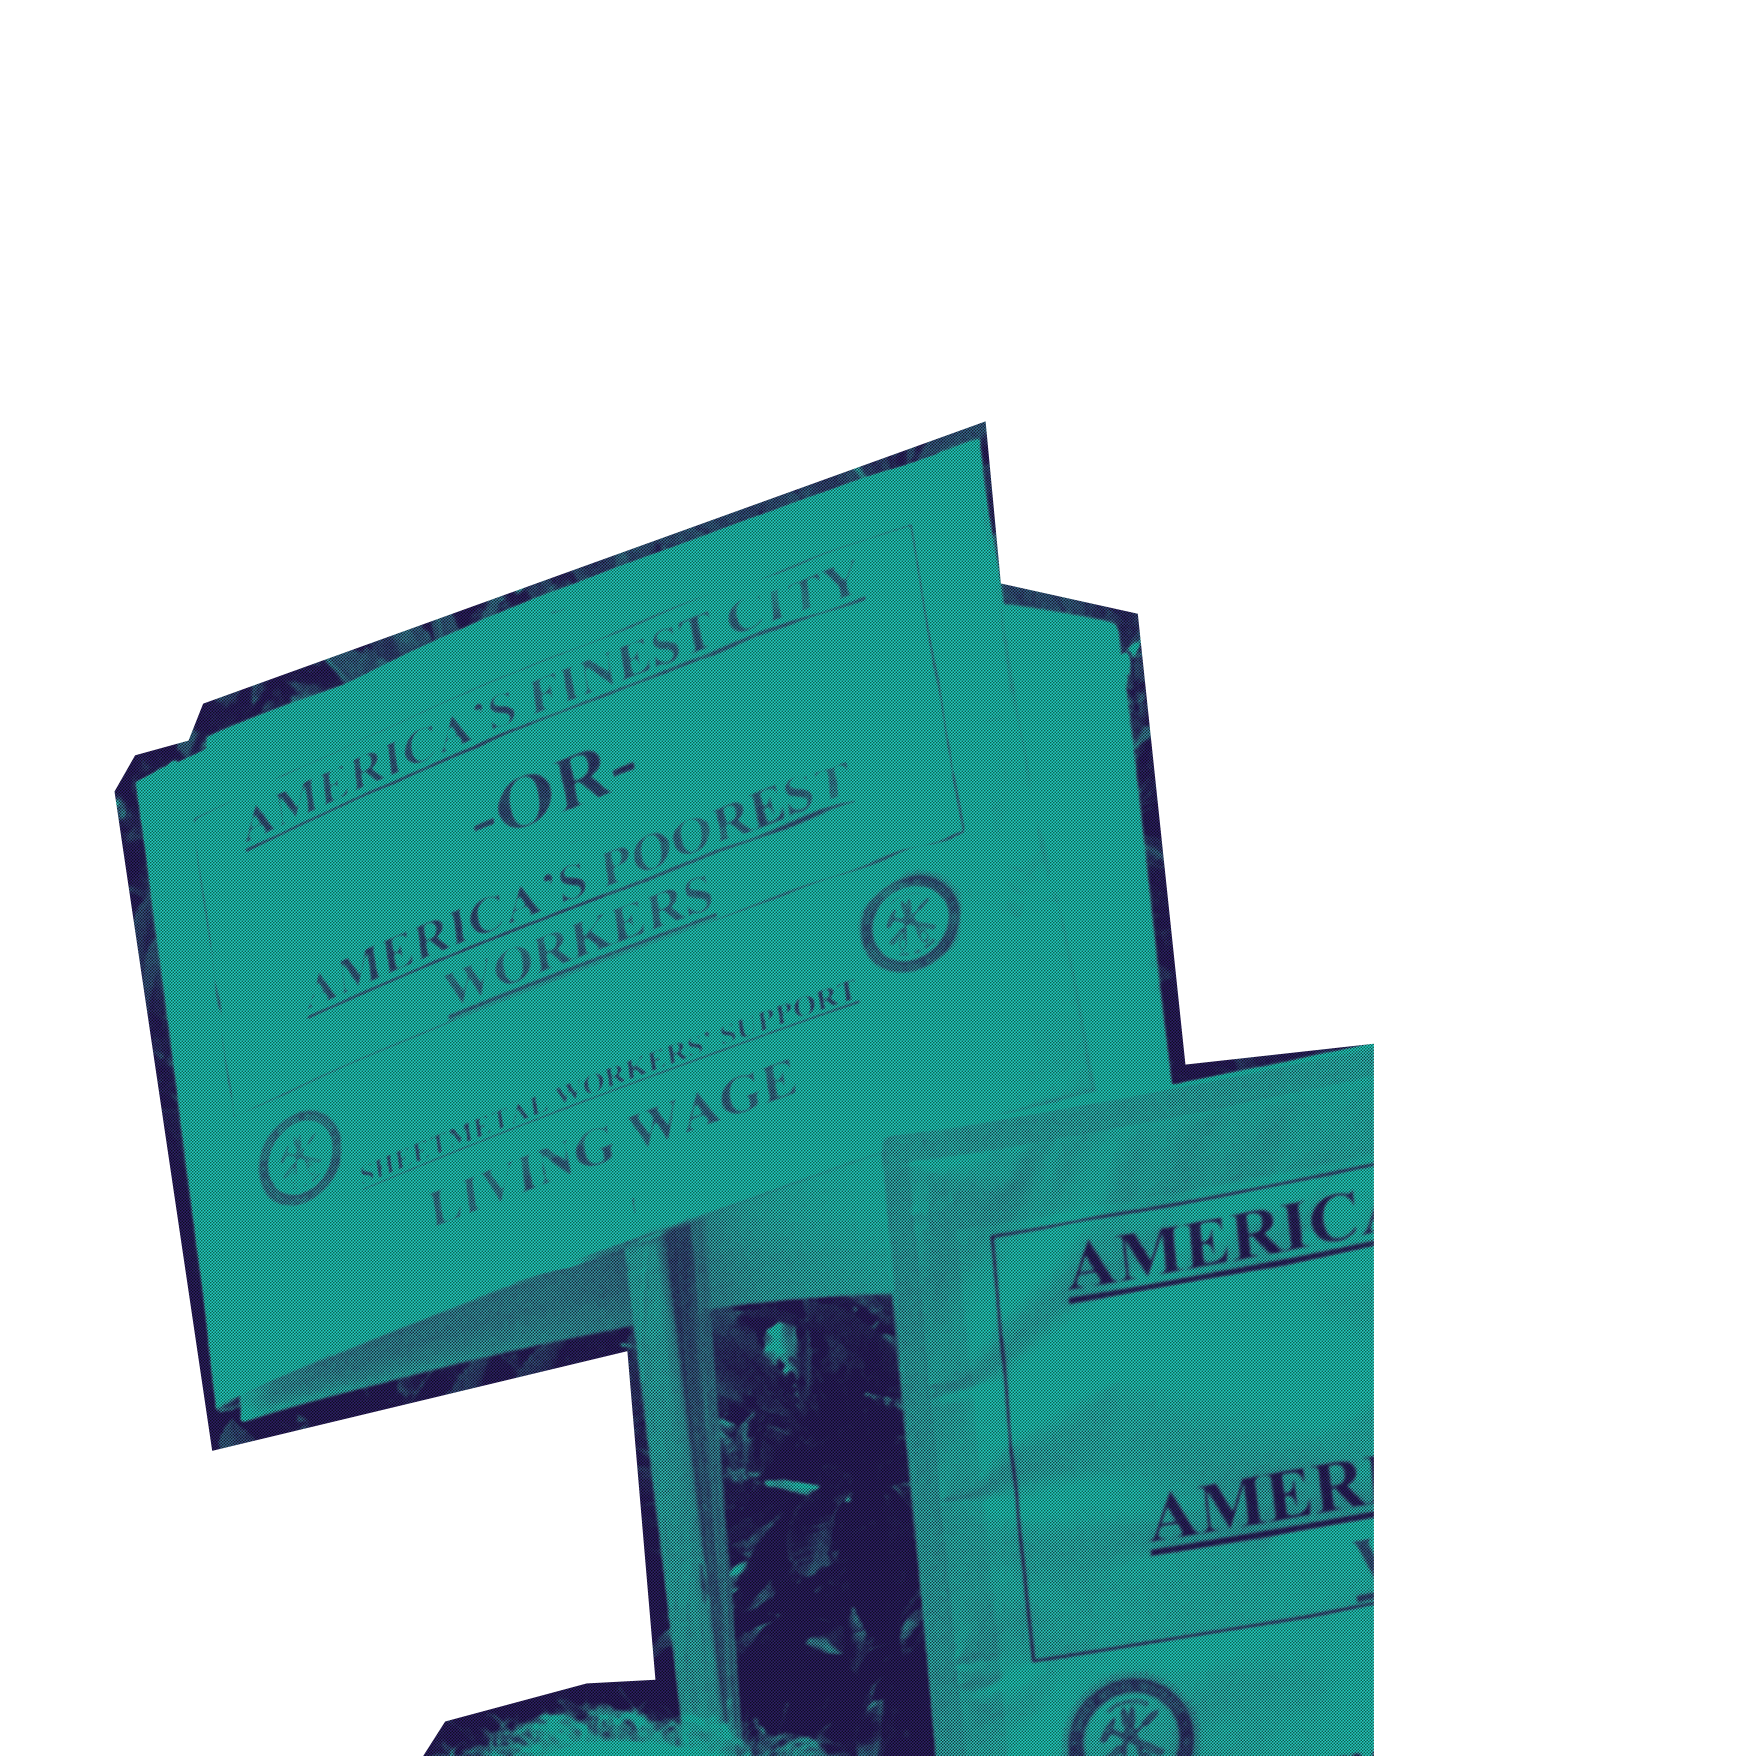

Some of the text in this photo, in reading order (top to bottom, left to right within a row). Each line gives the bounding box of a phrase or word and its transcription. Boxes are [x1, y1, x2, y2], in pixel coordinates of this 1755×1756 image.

[244, 559, 858, 846] AMERICA'S FINEST CITY
[471, 747, 637, 833] -OR-
[305, 761, 851, 1011] AMERICA'S POOREST
[443, 873, 715, 1005] WORKERS
[358, 1094, 551, 1184] SHEETMETAL
[554, 1030, 714, 1106] WORKERS'
[719, 979, 859, 1045] SUPPORT
[428, 1123, 615, 1229] LIVING
[627, 1057, 798, 1148] WAGE
[1068, 1188, 1374, 1292] AMERIC
[1150, 1456, 1374, 1543] AMER
